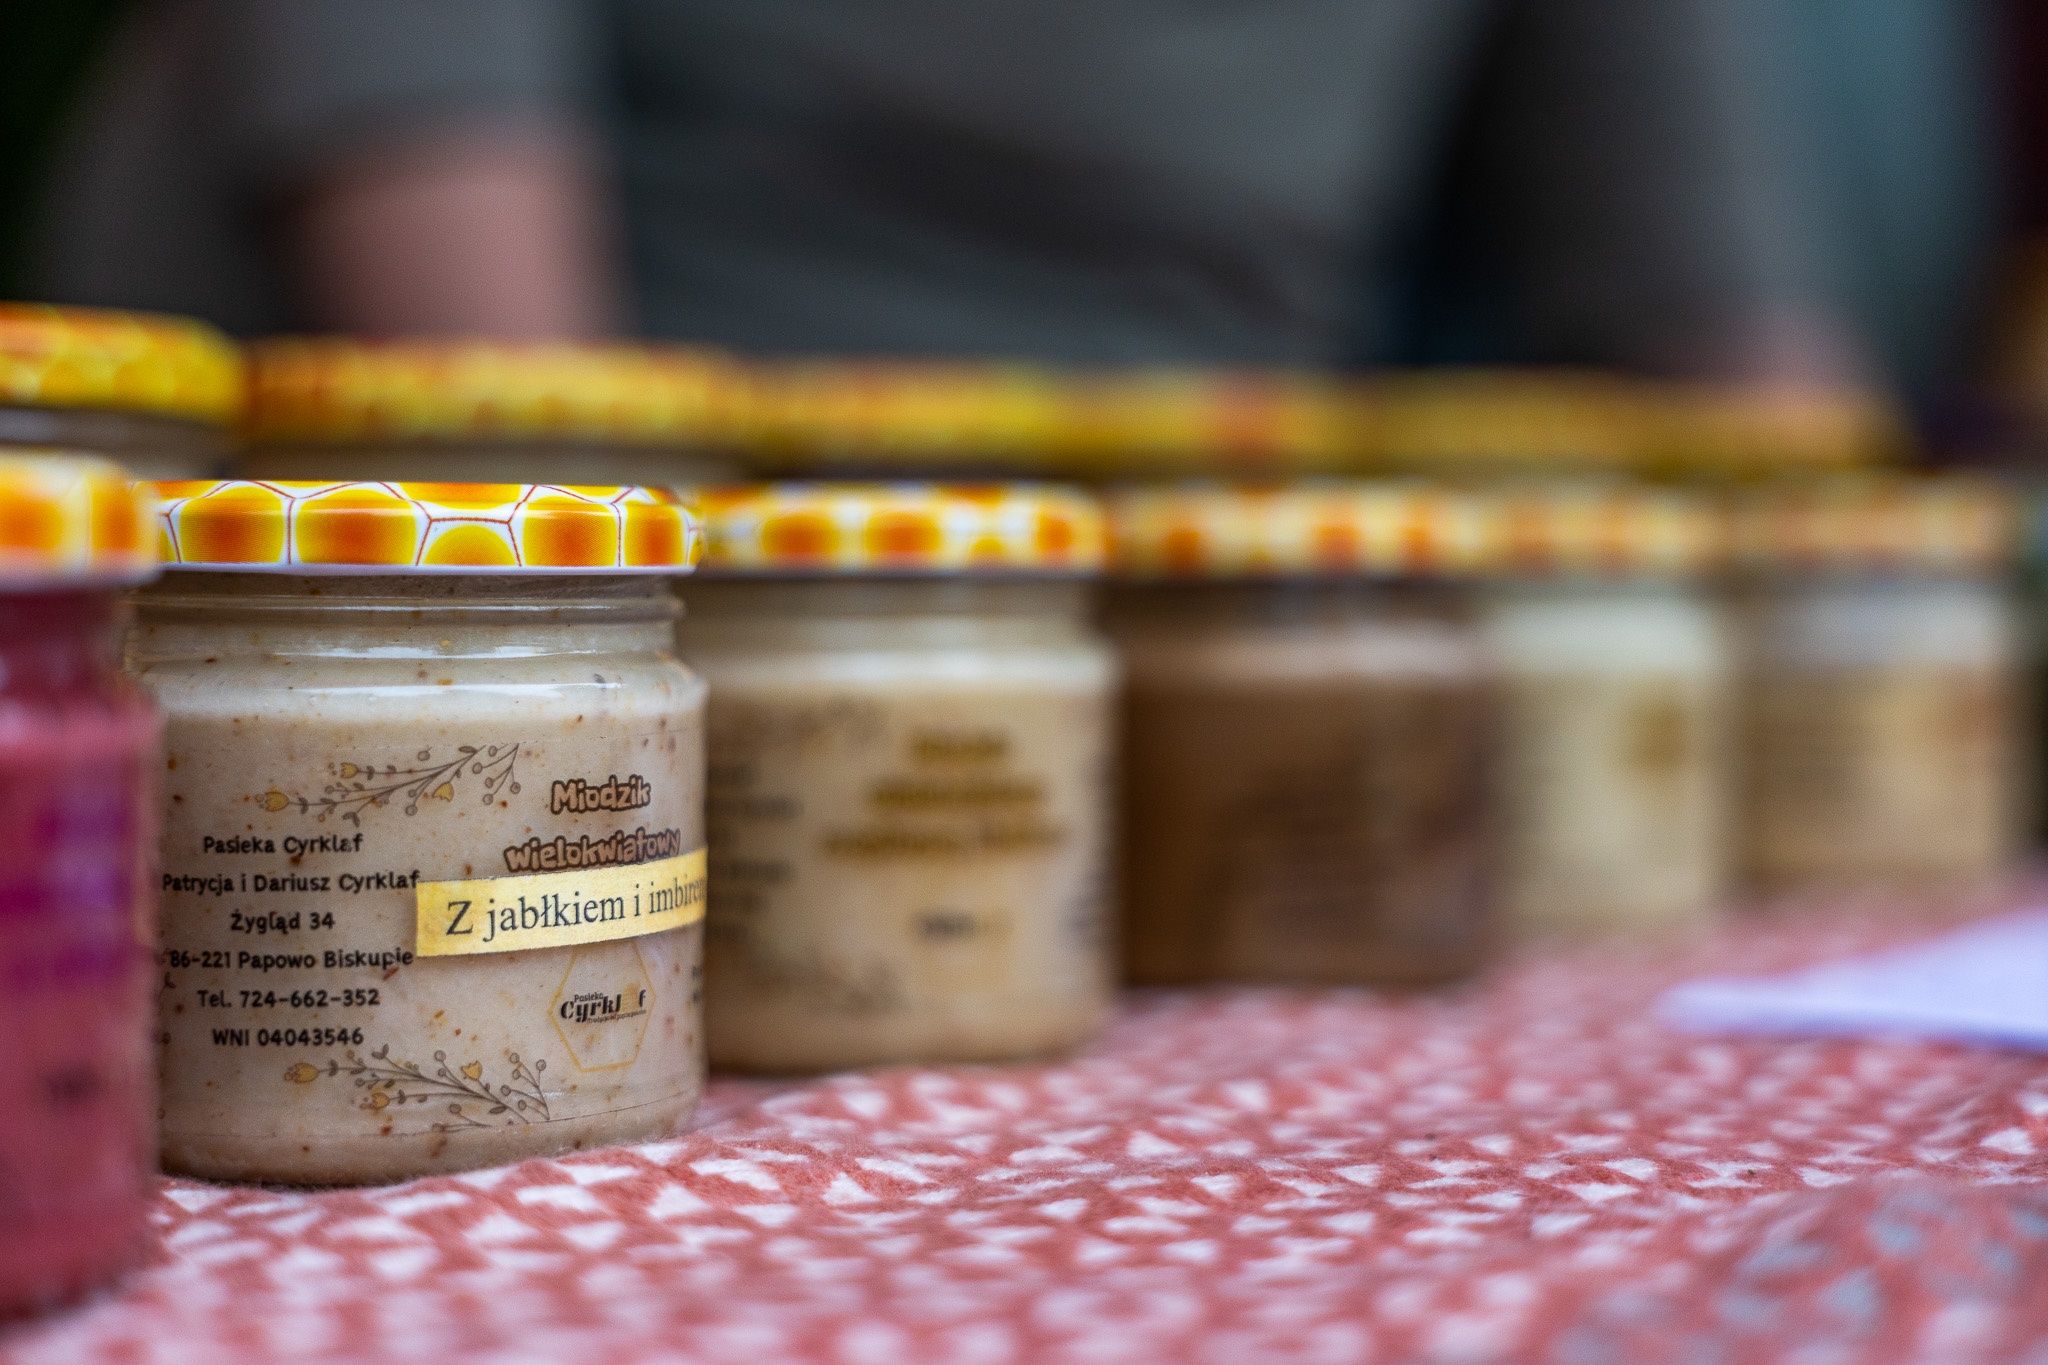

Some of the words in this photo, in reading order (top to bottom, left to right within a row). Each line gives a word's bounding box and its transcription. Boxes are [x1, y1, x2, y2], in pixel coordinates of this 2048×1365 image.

[551, 774, 651, 815] Miodzik
[203, 836, 275, 854] Pasieka
[283, 833, 363, 856] Cyrklaf
[162, 873, 234, 895] Patrycja
[241, 873, 247, 892] i
[253, 874, 331, 892] Dariusz
[338, 870, 421, 894] Cyrklaf
[309, 912, 335, 930] 34
[446, 900, 473, 936] Z
[483, 891, 625, 942] jabłkiem
[634, 884, 641, 917] i
[169, 950, 232, 969] 86-221
[238, 951, 316, 972] Papowo
[324, 947, 414, 970] Biskupie
[197, 990, 232, 1008] Tel.
[240, 988, 381, 1008] 724-662-352
[212, 1028, 249, 1047] WNI
[257, 1027, 365, 1046] 04043546
